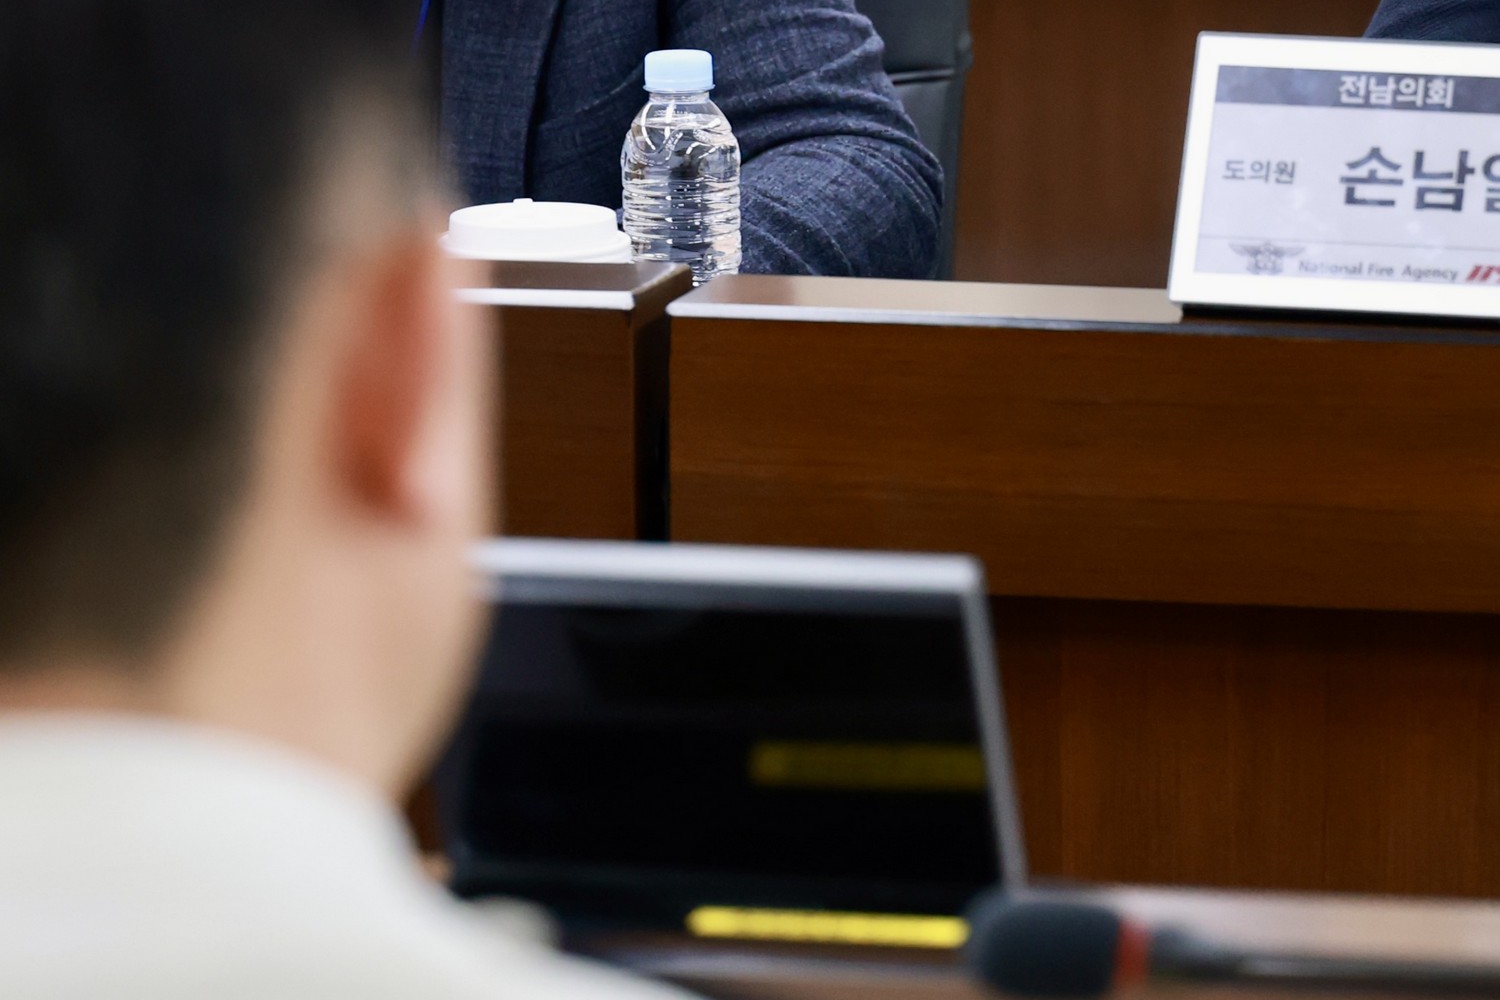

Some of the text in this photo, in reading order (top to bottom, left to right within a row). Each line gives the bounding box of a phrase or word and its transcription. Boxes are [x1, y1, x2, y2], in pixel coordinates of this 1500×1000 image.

[1338, 74, 1455, 108] 전남의회
[1222, 158, 1297, 185] 도의원
[1299, 259, 1363, 276] National
[1367, 263, 1394, 277] Fire
[1401, 266, 1458, 282] Agency
